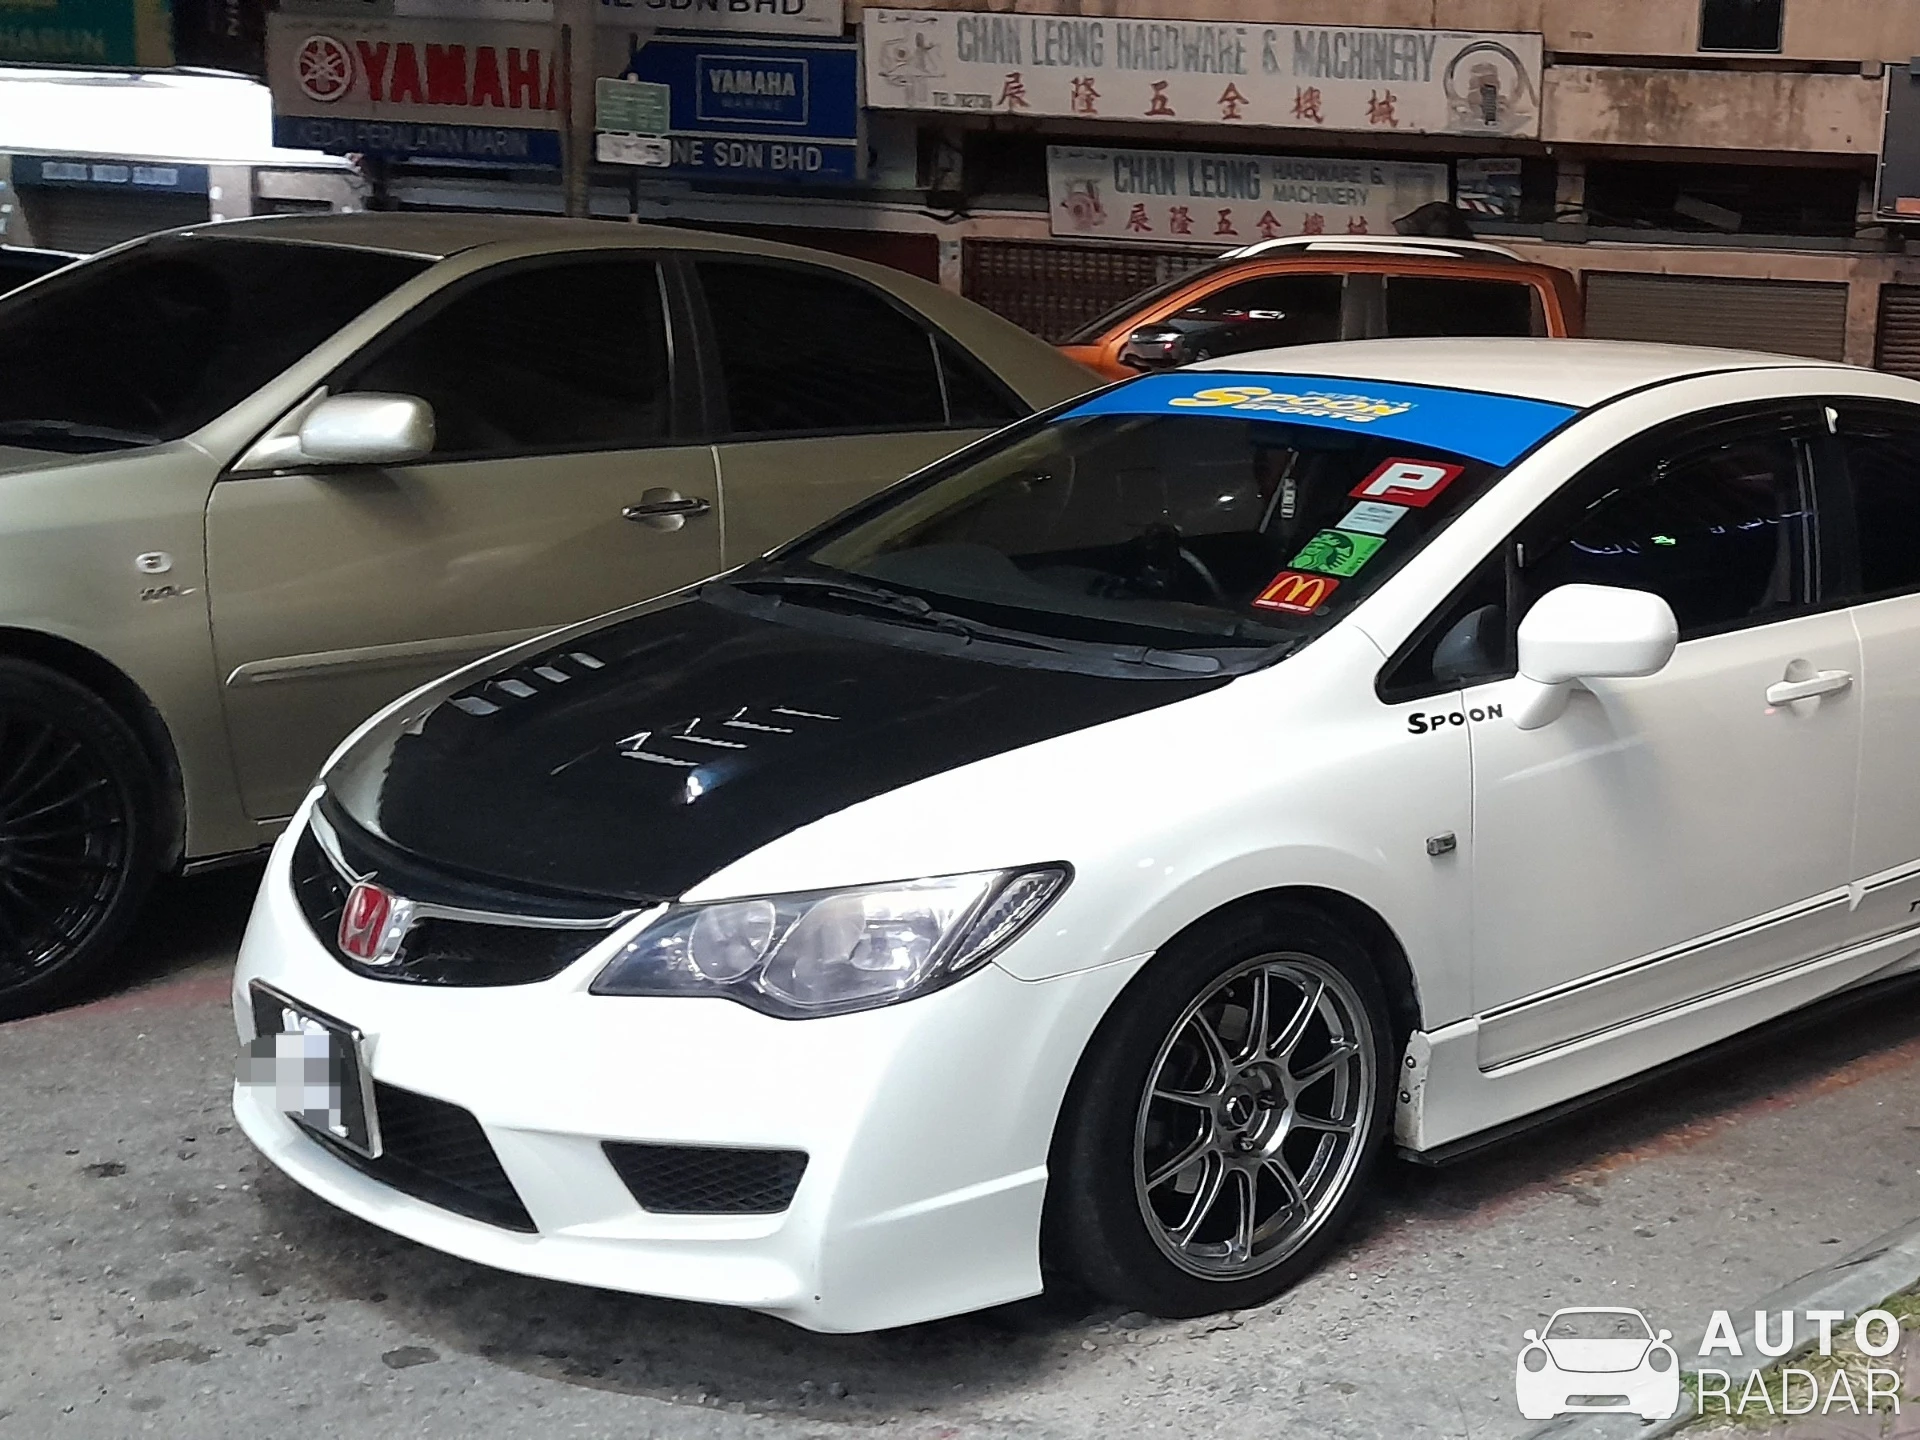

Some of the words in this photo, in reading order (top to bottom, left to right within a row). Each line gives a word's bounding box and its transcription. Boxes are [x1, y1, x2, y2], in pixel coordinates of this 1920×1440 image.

[956, 15, 1022, 66] CHAN
[1031, 17, 1104, 68] LEONG
[1116, 22, 1248, 76] HARDWARE
[1262, 28, 1282, 75] &
[1292, 29, 1437, 83] MACHINERY
[709, 68, 796, 97] YAMAHA
[713, 141, 764, 169] SDN
[770, 144, 823, 172] BHD
[1113, 154, 1176, 196] CHAN
[1187, 157, 1261, 201] LEONG
[1272, 162, 1362, 185] HARDWARE
[1370, 166, 1386, 187] &
[1272, 183, 1369, 207] MACHINERY
[1168, 386, 1412, 416] SPOON
[1231, 403, 1376, 423] SPORTS
[1361, 462, 1447, 496] P
[1407, 703, 1504, 735] SPOON
